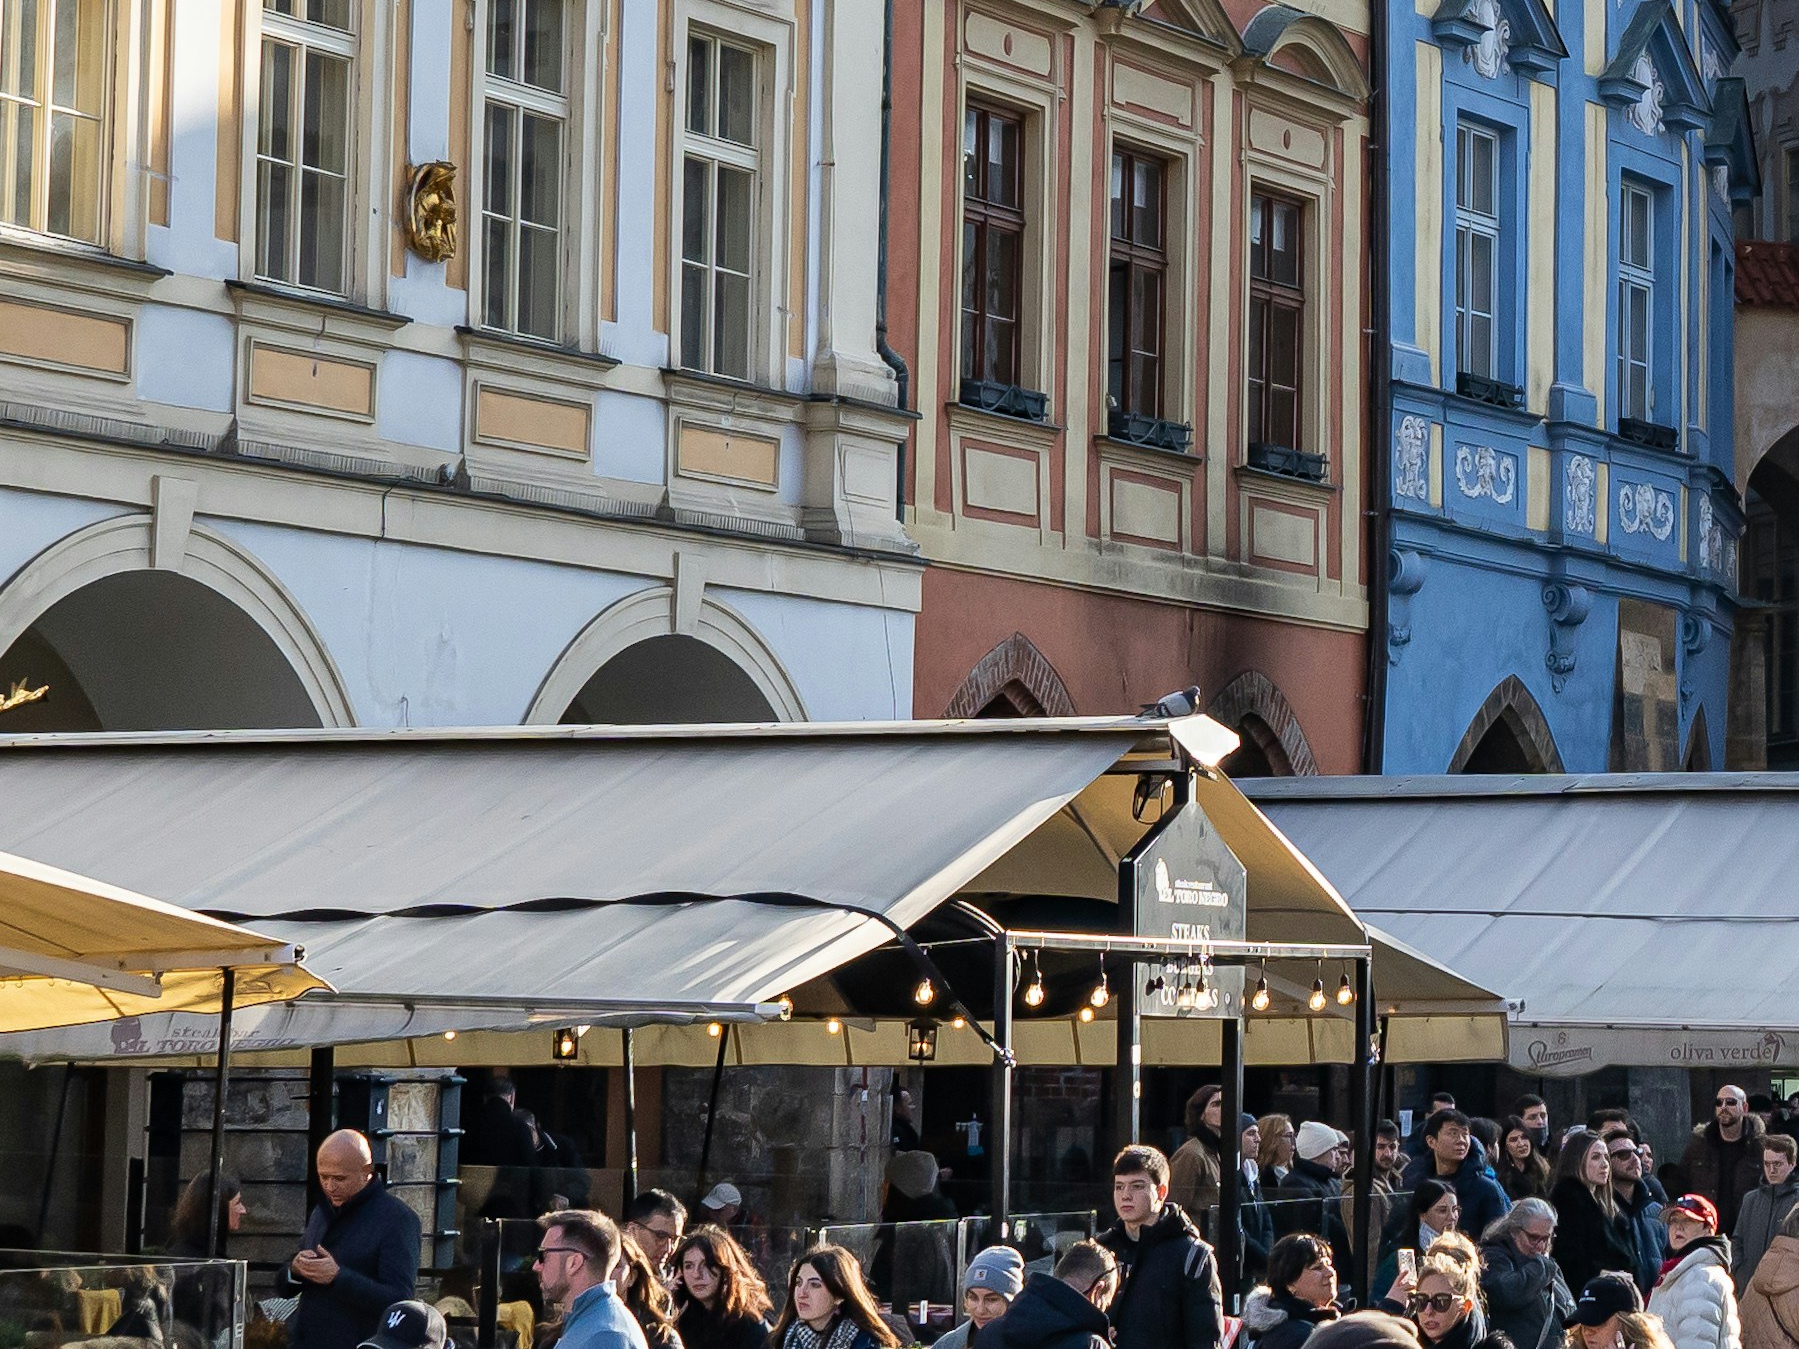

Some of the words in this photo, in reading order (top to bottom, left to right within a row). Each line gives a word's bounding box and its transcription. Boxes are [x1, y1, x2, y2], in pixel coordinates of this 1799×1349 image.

[1171, 922, 1210, 941] STEAKS
[1670, 1041, 1714, 1061] oliva
[1720, 1040, 1772, 1061] verde
